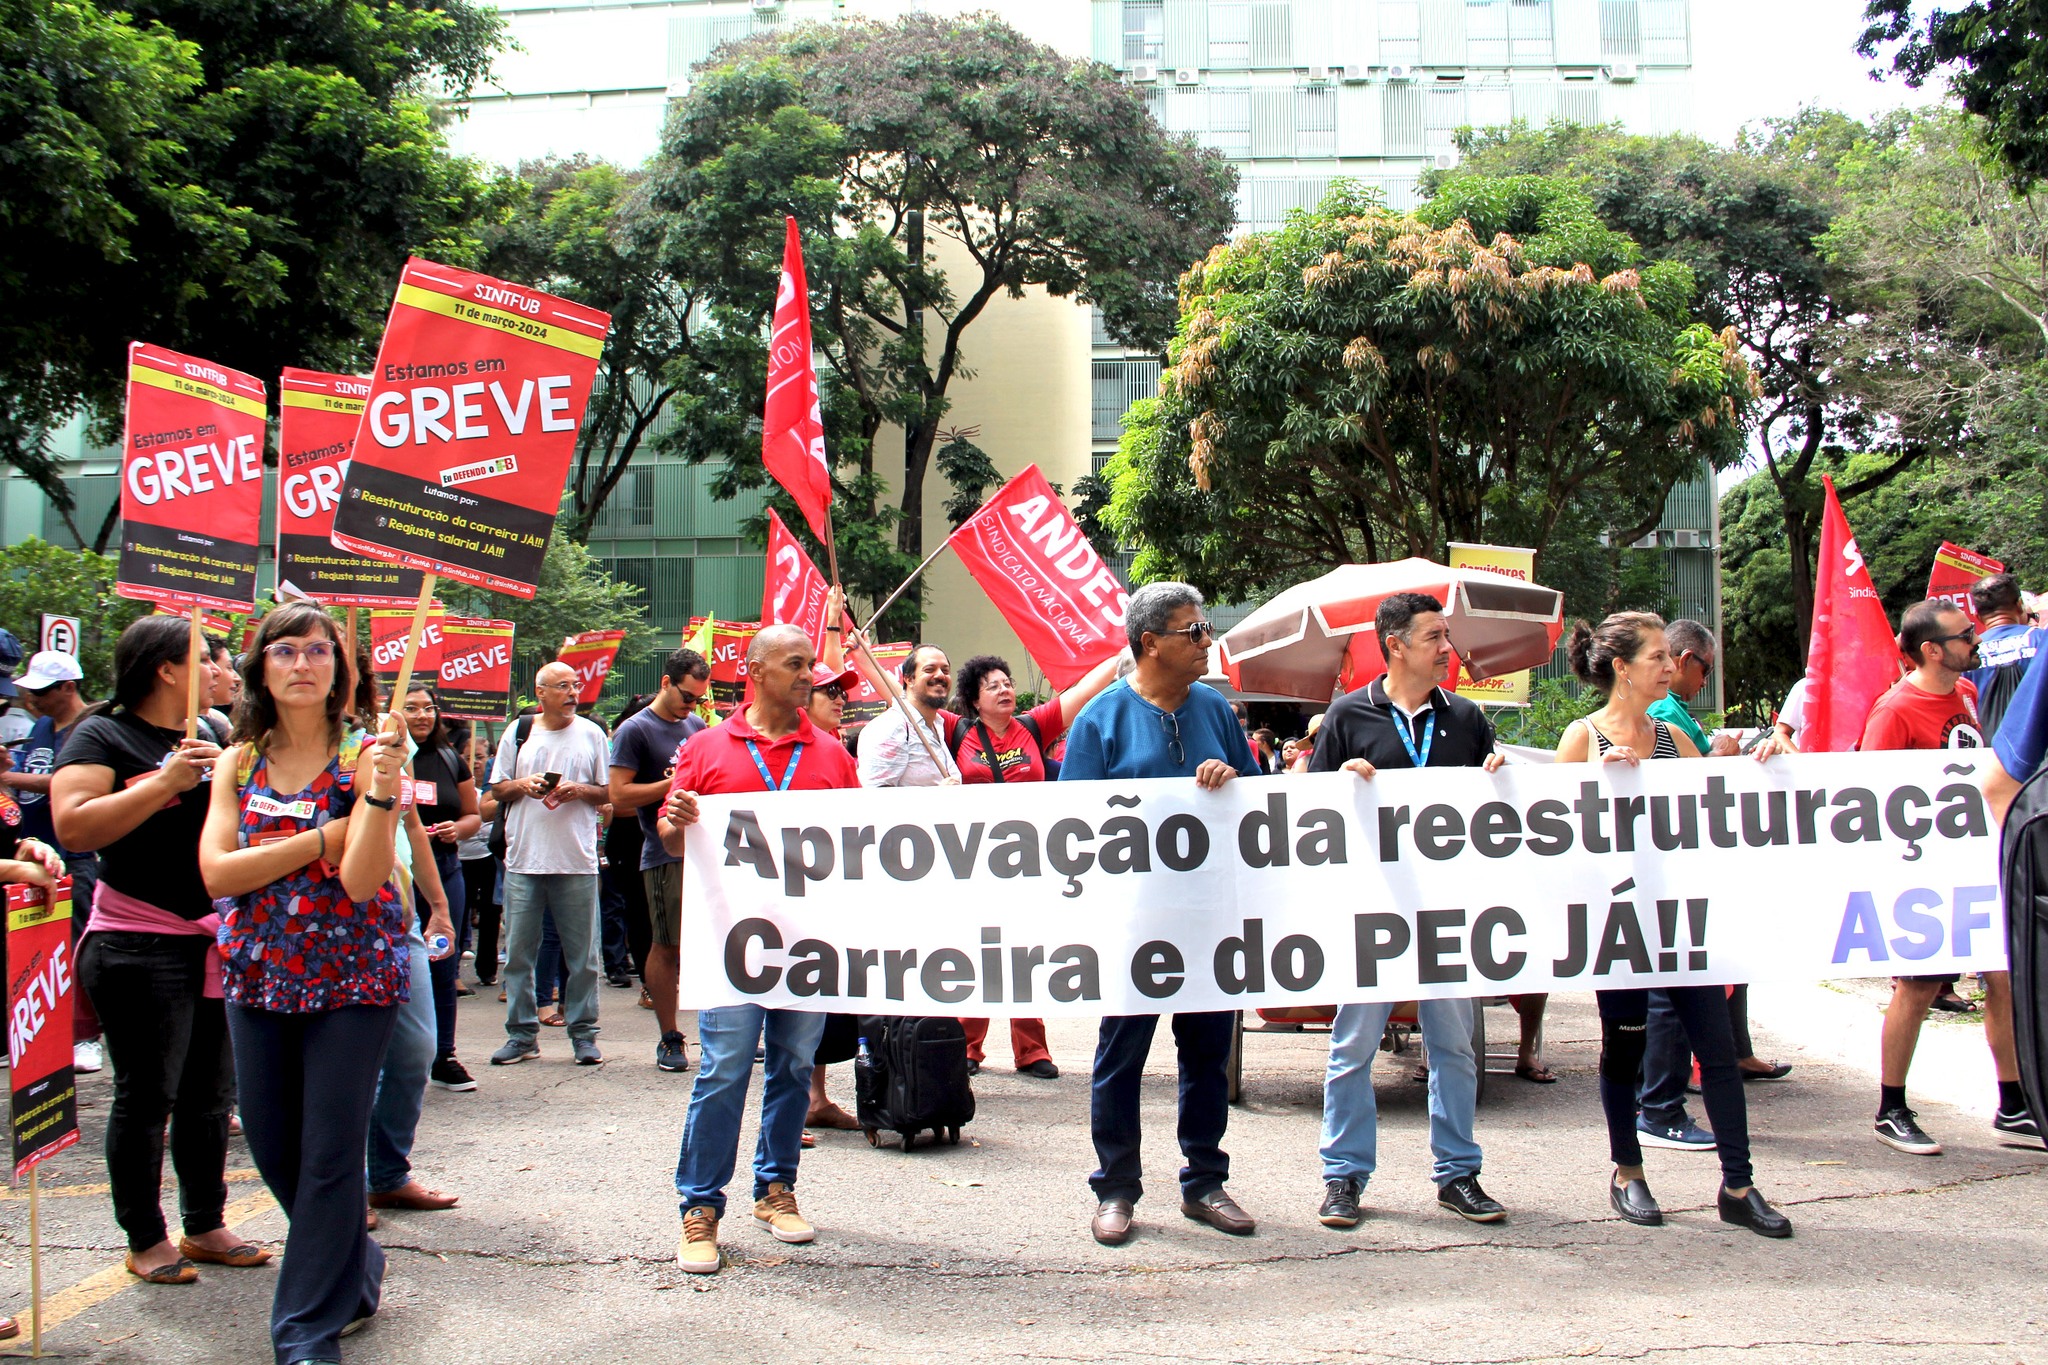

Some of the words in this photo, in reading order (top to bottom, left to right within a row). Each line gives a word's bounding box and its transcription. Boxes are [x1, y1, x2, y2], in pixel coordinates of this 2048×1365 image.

[474, 283, 541, 315] SINTFUB
[454, 303, 465, 315] 11
[467, 307, 481, 319] de
[482, 313, 548, 339] março-2024
[184, 363, 228, 386] SINTFUB
[385, 361, 469, 382] Estamos
[474, 357, 506, 373] em
[184, 382, 194, 391] de
[324, 399, 332, 407] 11
[334, 401, 343, 409] de
[369, 375, 576, 448] GREVE
[133, 427, 194, 449] Estamos
[196, 424, 218, 436] em
[286, 442, 346, 468] Estamos
[127, 434, 261, 505] GREVE
[443, 475, 452, 483] Eu
[453, 466, 486, 481] DEFENDO
[423, 486, 458, 502] Lutamos
[459, 496, 479, 506] por:
[361, 490, 449, 523] Reestruturação
[452, 515, 467, 528] da
[470, 523, 518, 542] carreira
[520, 533, 545, 549] JÁ!!!
[388, 518, 436, 540] Reajuste
[438, 531, 480, 551] salarial
[481, 543, 505, 558] JÁ!!!
[135, 543, 200, 562] Reestruturação
[294, 554, 360, 567] Reestruturação
[361, 559, 371, 567] da
[1006, 494, 1131, 627] ANDES
[1960, 552, 1982, 566] SINTFUB
[158, 564, 193, 578] Reajuste
[318, 571, 354, 581] Reajuste
[981, 515, 1036, 587] SINDICATO
[1033, 587, 1093, 651] NACIONAL
[56, 628, 68, 652] E
[441, 644, 509, 681] GREVE
[724, 793, 1210, 899] Aprovação
[1238, 792, 1347, 868] da
[1377, 763, 1988, 863] reestruturaçã
[1831, 883, 1998, 965] ASF
[724, 917, 1100, 1003] Carreira
[1130, 939, 1185, 999] e
[1213, 919, 1325, 996] do
[1354, 905, 1527, 988] PEC
[1553, 876, 1709, 978] JÁ!!
